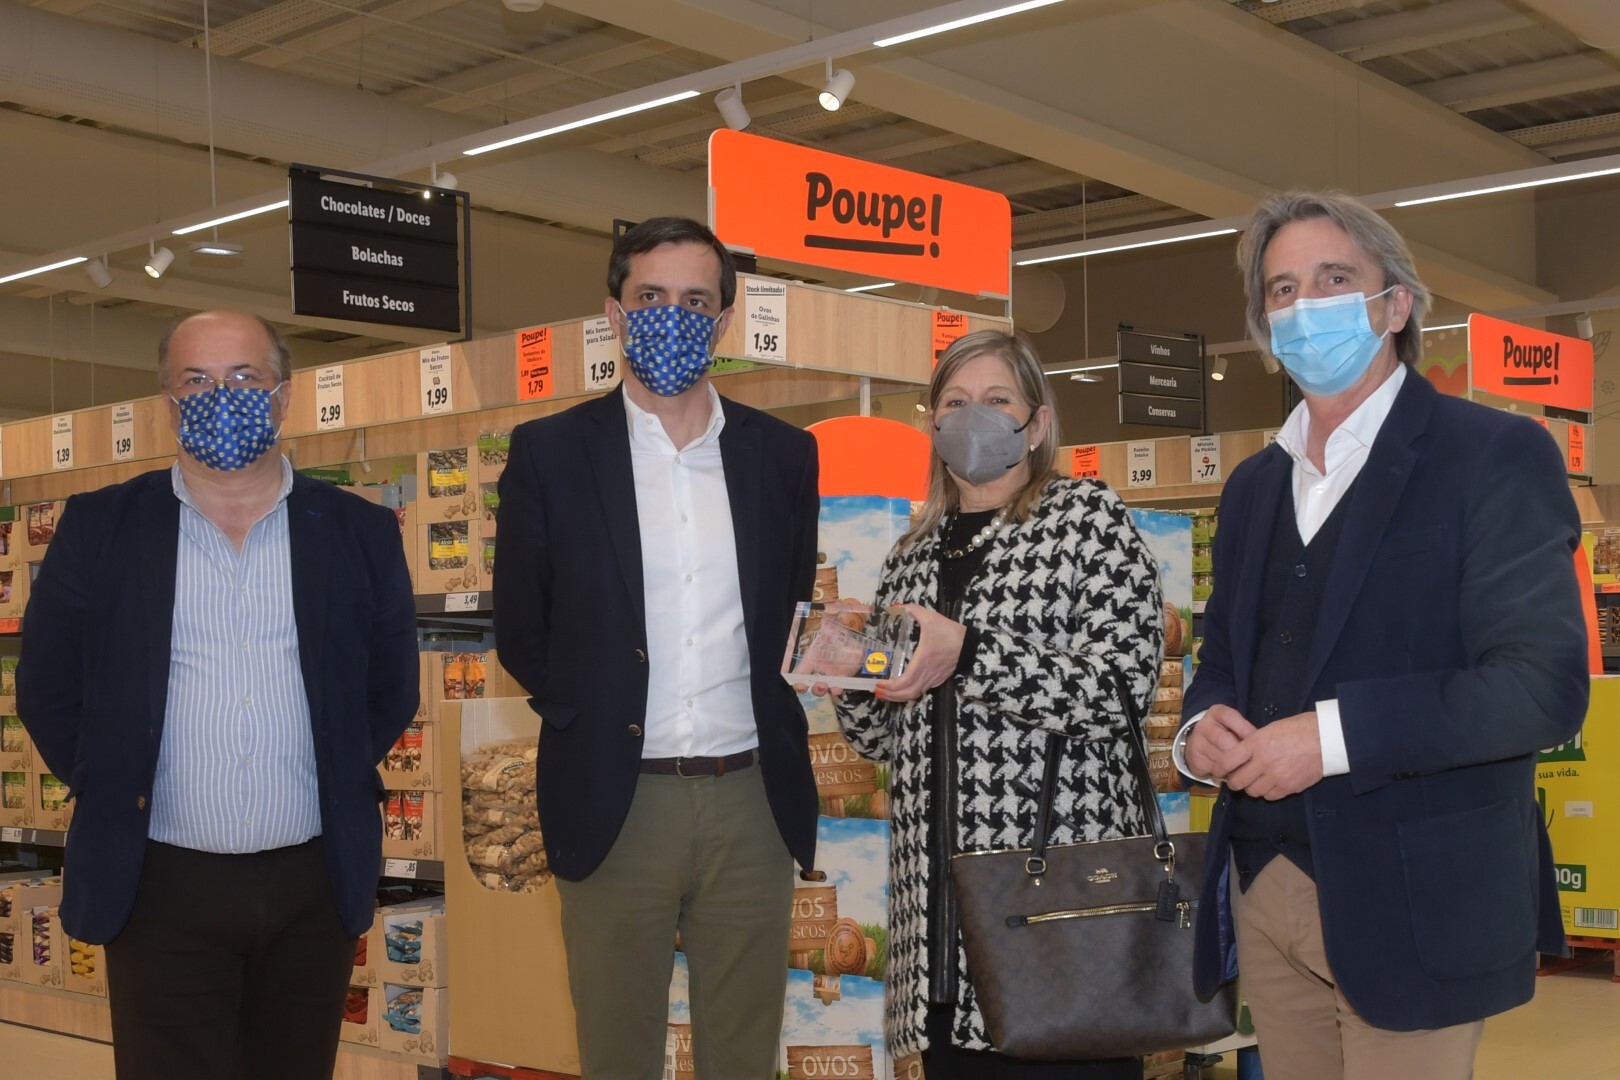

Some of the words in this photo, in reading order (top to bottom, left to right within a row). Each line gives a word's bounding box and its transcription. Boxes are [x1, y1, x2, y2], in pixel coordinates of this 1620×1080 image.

[320, 195, 386, 219] Chocolates
[387, 205, 394, 223] /
[396, 207, 431, 227] Doces
[805, 171, 943, 258] Poupe!
[351, 245, 404, 267] Bolachas
[746, 285, 760, 293] Stock
[760, 286, 785, 296] limitado!
[342, 290, 380, 309] Frutos
[382, 295, 415, 313] Secos
[758, 305, 772, 314] Ovos
[758, 313, 780, 323] Galinhas
[936, 312, 963, 327] Poupe!
[521, 327, 547, 345] Poupe!
[586, 336, 599, 345] para
[753, 332, 778, 352] 1,95
[1150, 344, 1171, 357] Vinhos
[1502, 335, 1560, 385] Poupe!
[590, 360, 615, 383] 1,99
[527, 380, 544, 395] 1,79
[1149, 375, 1177, 388] Mercearia
[426, 387, 448, 408] 1,99
[320, 404, 341, 424] 2,99
[1147, 405, 1177, 418] Conservas
[115, 438, 131, 455] 1,99
[56, 448, 70, 464] 1,39
[1131, 469, 1152, 482] 3,99
[1197, 464, 1216, 478] -,77
[464, 594, 478, 605] 3,49
[1538, 771, 1555, 780] sua
[1556, 767, 1580, 778] vida.
[802, 1055, 860, 1077] OVOS
